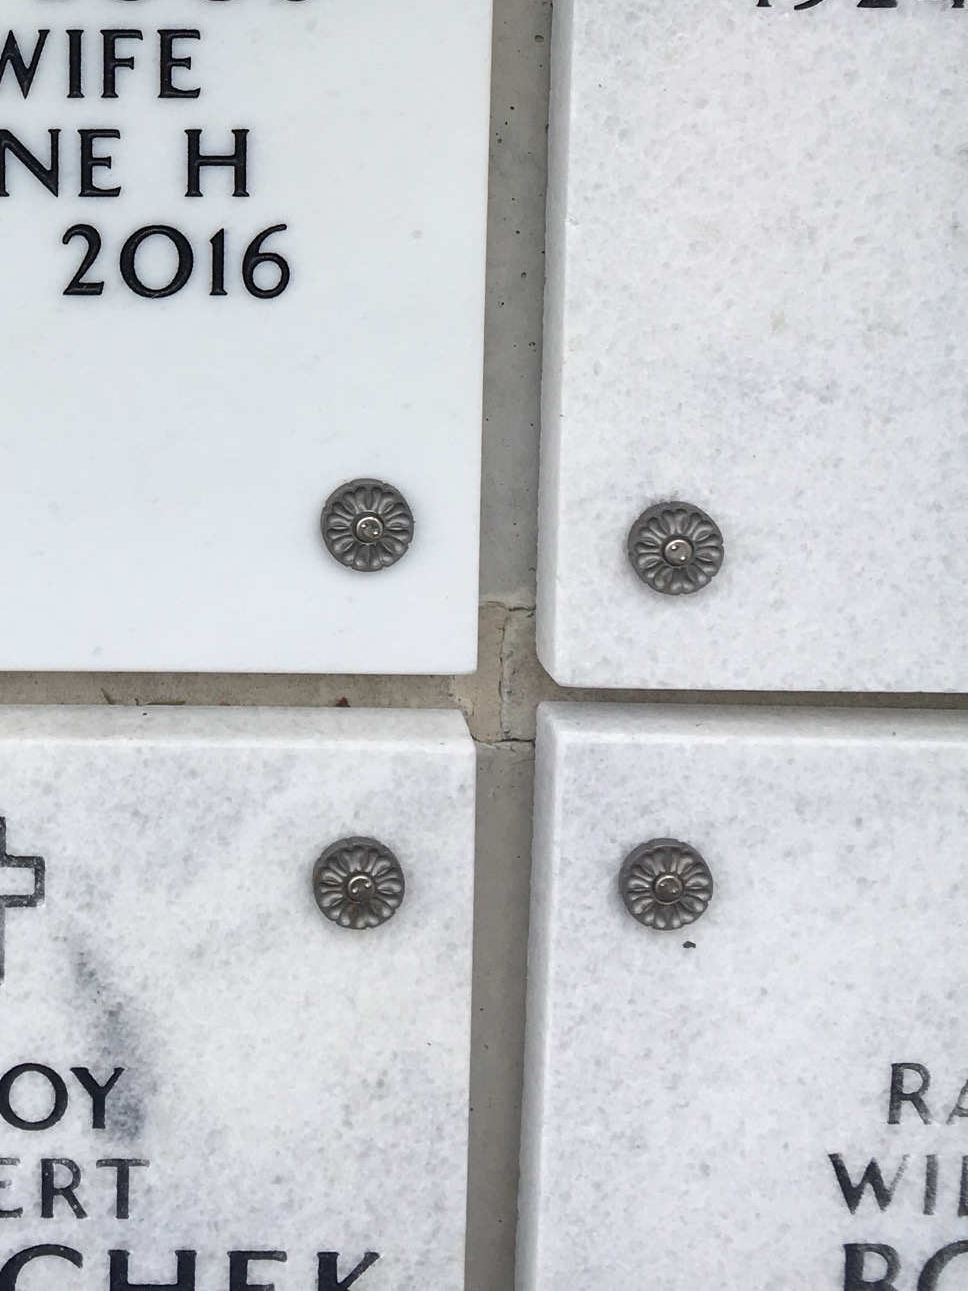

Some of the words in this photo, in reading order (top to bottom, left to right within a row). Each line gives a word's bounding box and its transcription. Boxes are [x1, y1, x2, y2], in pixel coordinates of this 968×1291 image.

[184, 128, 250, 198] H
[61, 223, 291, 300] 2016
[828, 1152, 968, 1218] WI
